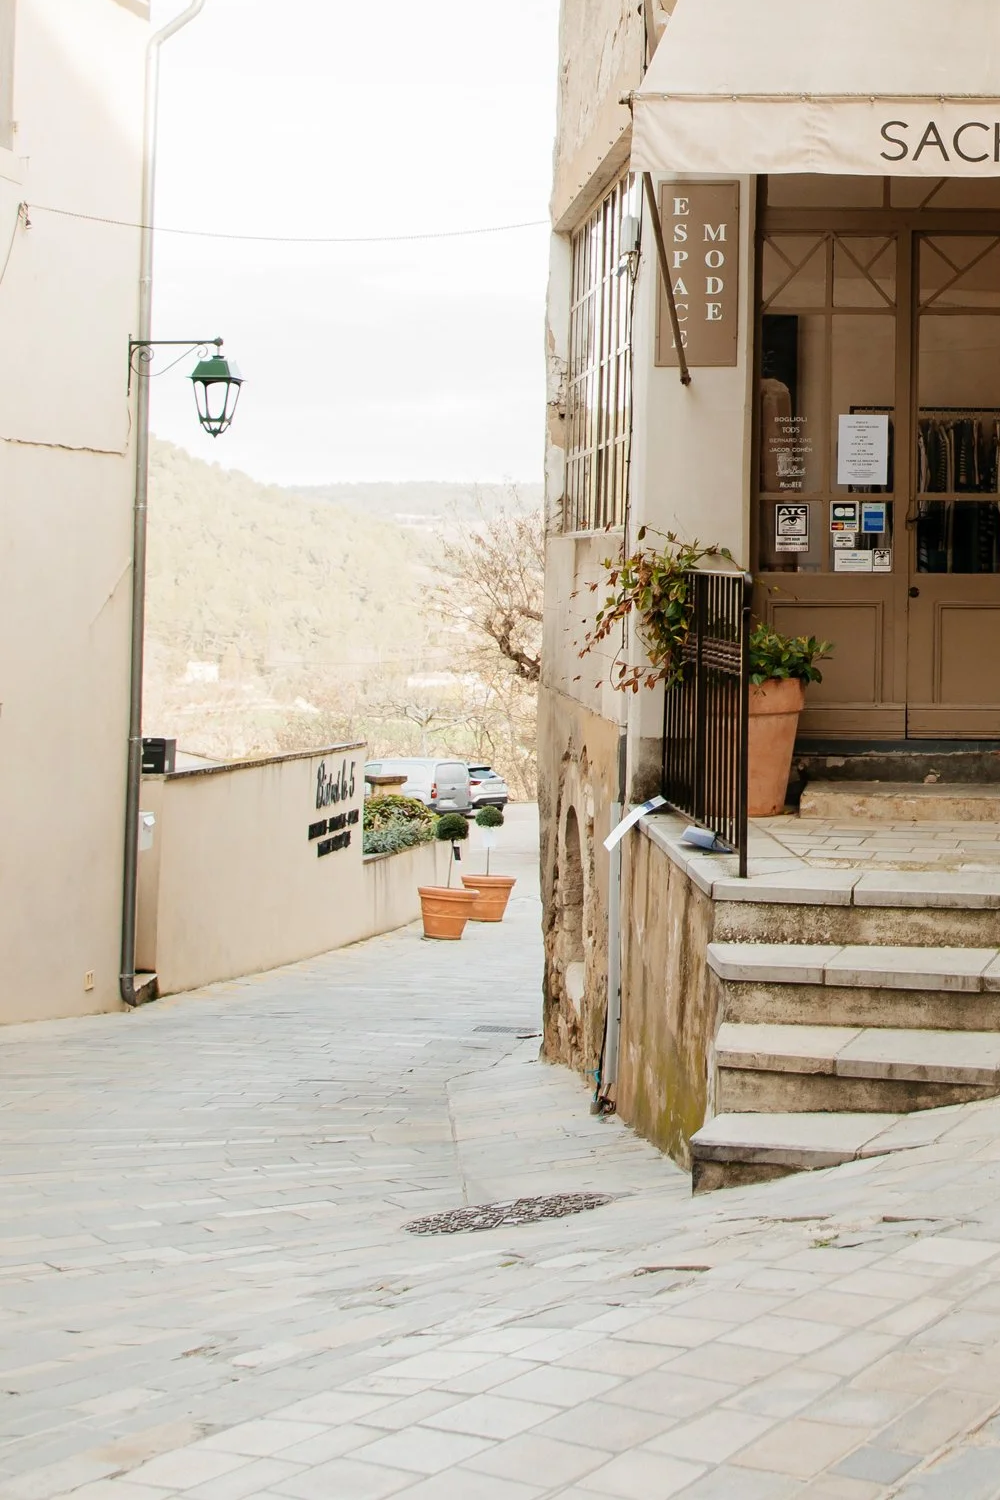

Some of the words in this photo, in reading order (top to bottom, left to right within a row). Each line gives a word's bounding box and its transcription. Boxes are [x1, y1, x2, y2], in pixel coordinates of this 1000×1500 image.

[703, 223, 728, 321] MODE
[834, 507, 855, 516] CB
[349, 761, 356, 798] 5
